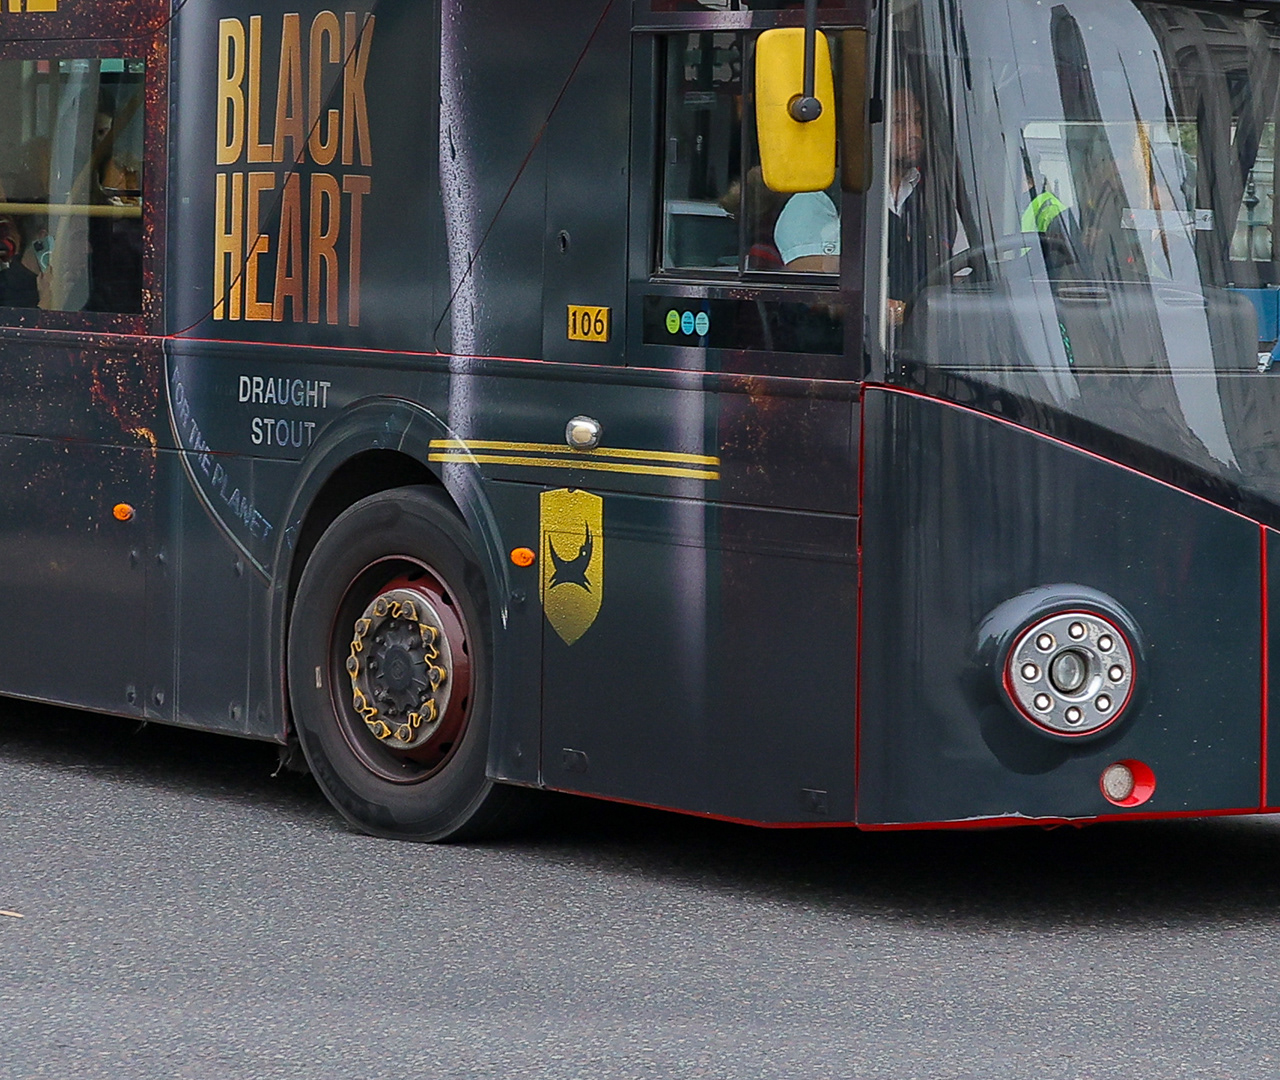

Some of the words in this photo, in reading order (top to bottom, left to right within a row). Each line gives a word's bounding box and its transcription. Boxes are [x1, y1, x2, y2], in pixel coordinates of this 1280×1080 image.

[216, 10, 376, 167] BLACK
[213, 171, 372, 327] HEART
[571, 309, 605, 336] 106
[238, 375, 331, 408] DRAUGHT
[250, 416, 316, 448] STOUT
